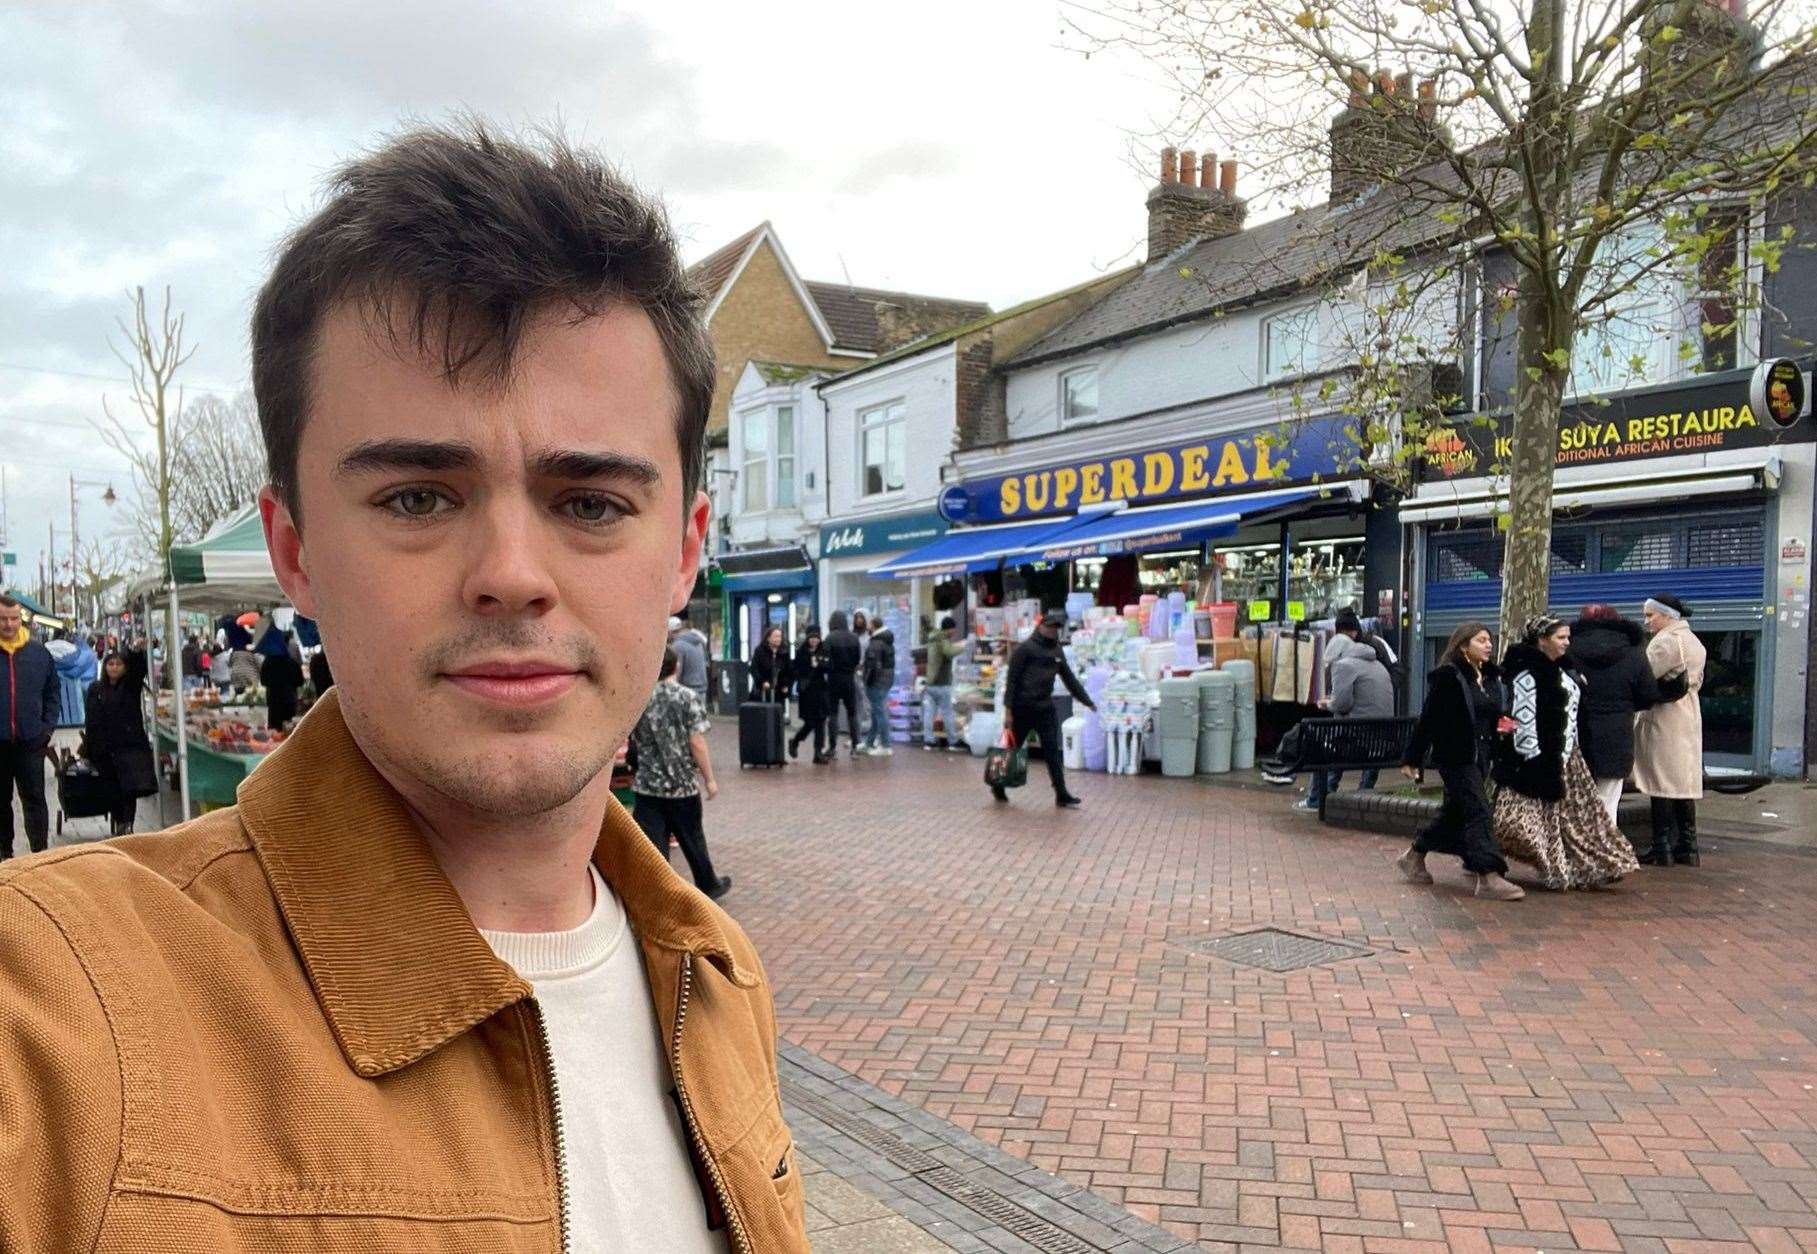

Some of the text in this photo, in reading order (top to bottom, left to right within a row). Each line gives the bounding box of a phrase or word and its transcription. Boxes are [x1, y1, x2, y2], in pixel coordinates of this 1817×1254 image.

[1560, 422, 1621, 449] SUYA
[1628, 405, 1757, 441] RESTAURA
[1615, 438, 1671, 455] AFRICAN
[1674, 431, 1724, 449] CUISINE
[1428, 449, 1473, 465] AFRICAN
[1001, 438, 1276, 515] SUPERDEAL
